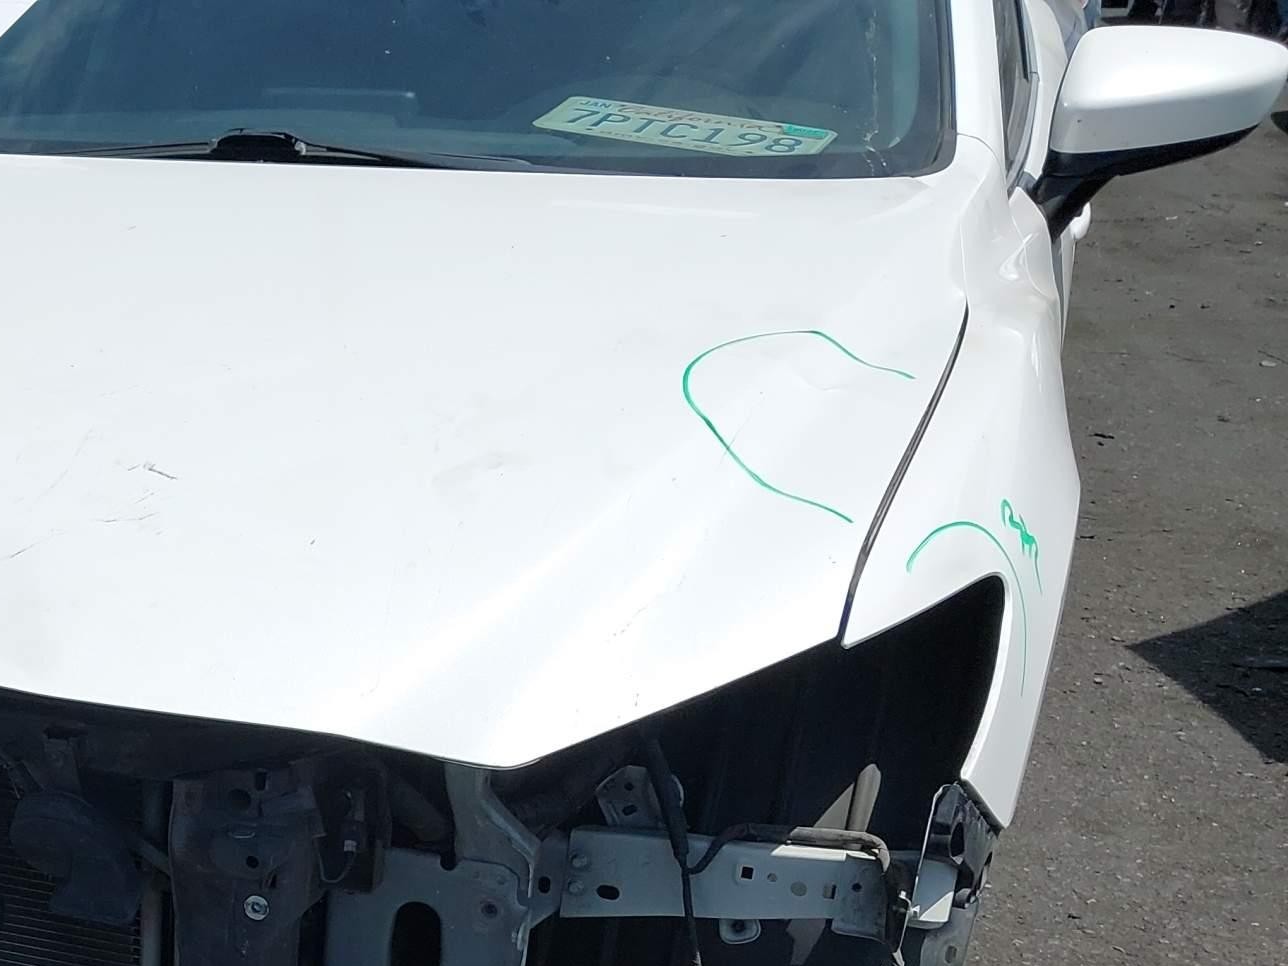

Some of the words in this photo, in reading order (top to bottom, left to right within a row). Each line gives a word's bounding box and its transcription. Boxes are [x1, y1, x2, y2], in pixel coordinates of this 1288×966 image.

[567, 107, 803, 154] 7PTC198
[578, 100, 612, 109] JAN
[615, 103, 783, 133] California
